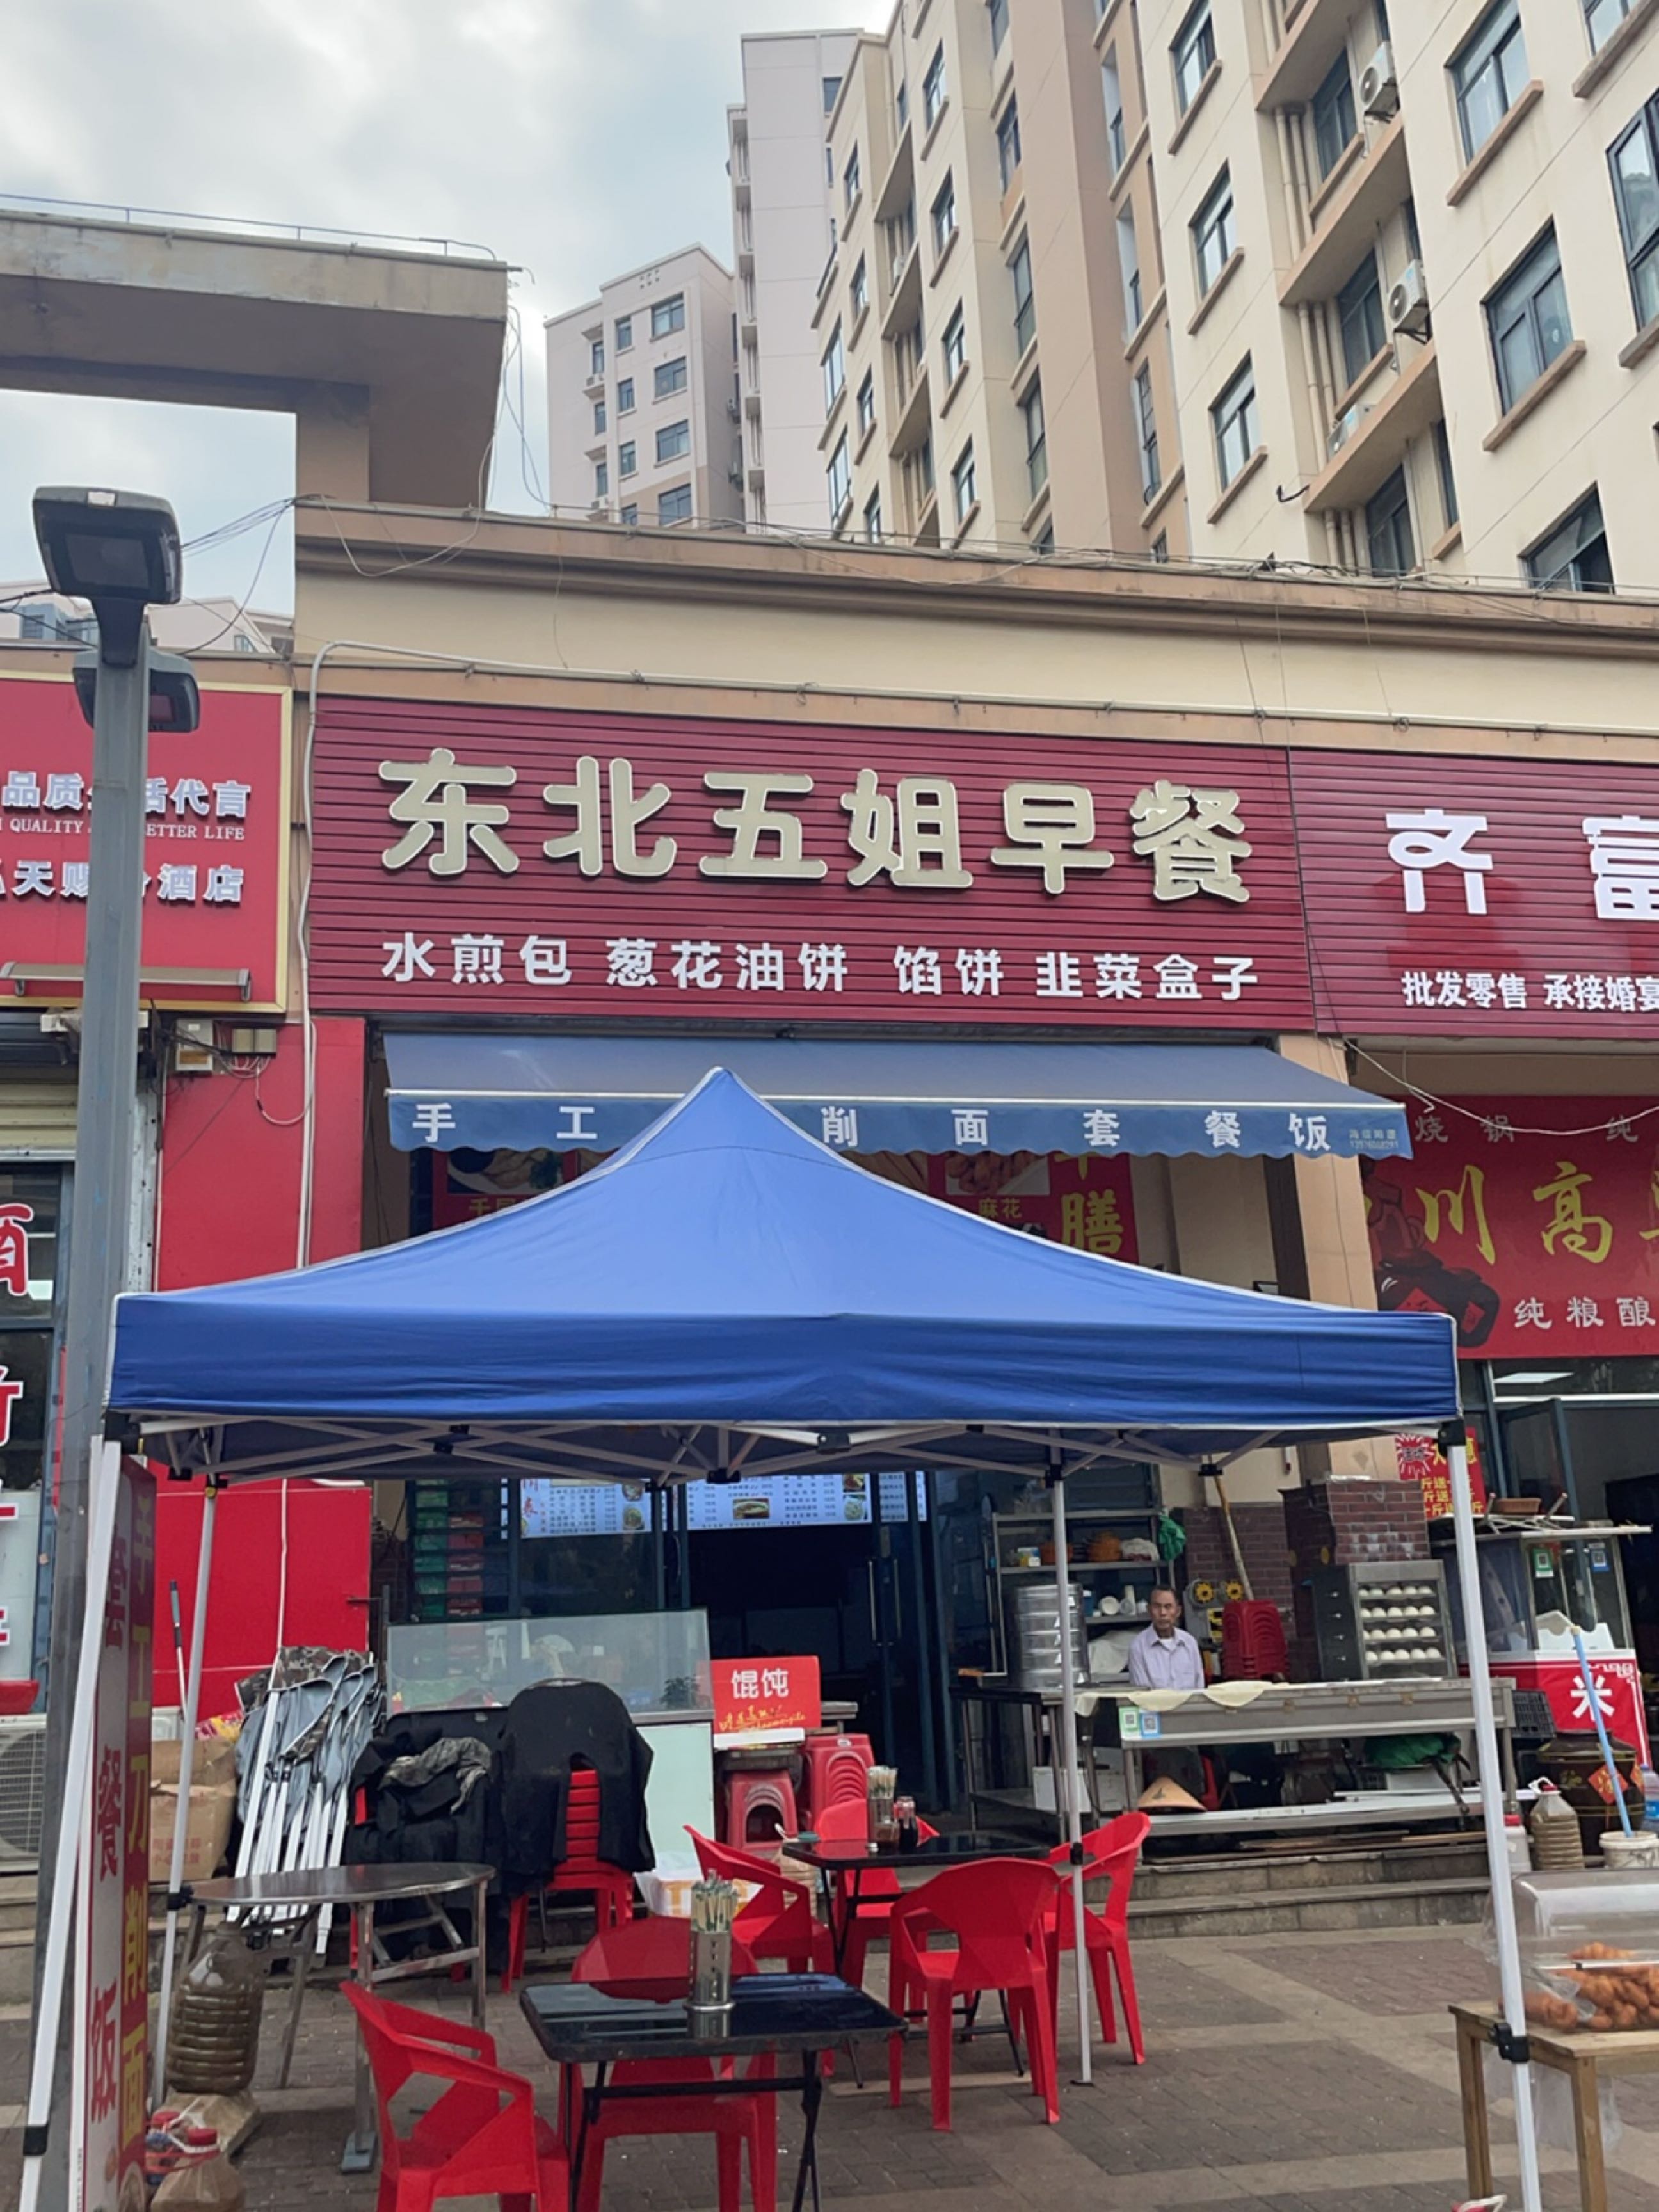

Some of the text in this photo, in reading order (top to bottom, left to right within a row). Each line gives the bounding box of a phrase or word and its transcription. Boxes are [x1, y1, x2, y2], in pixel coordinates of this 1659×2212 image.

[2, 770, 252, 818] 品质活代言
[10, 817, 84, 833] QUALITY
[146, 823, 197, 838] ETTER
[204, 825, 245, 840] LIFE
[378, 747, 1253, 903] 东北五姐早餐
[0, 858, 244, 902] 天赐酒店
[381, 932, 1258, 1001] 水煎包 葱花油饼 馅饼 韭菜盒子
[1400, 970, 1528, 1009] 批发零售
[978, 1198, 1023, 1219] 麻花
[1364, 1160, 1659, 1265] 川高
[1514, 1295, 1656, 1330] 纯粮酿
[730, 1667, 789, 1700] 馄饨
